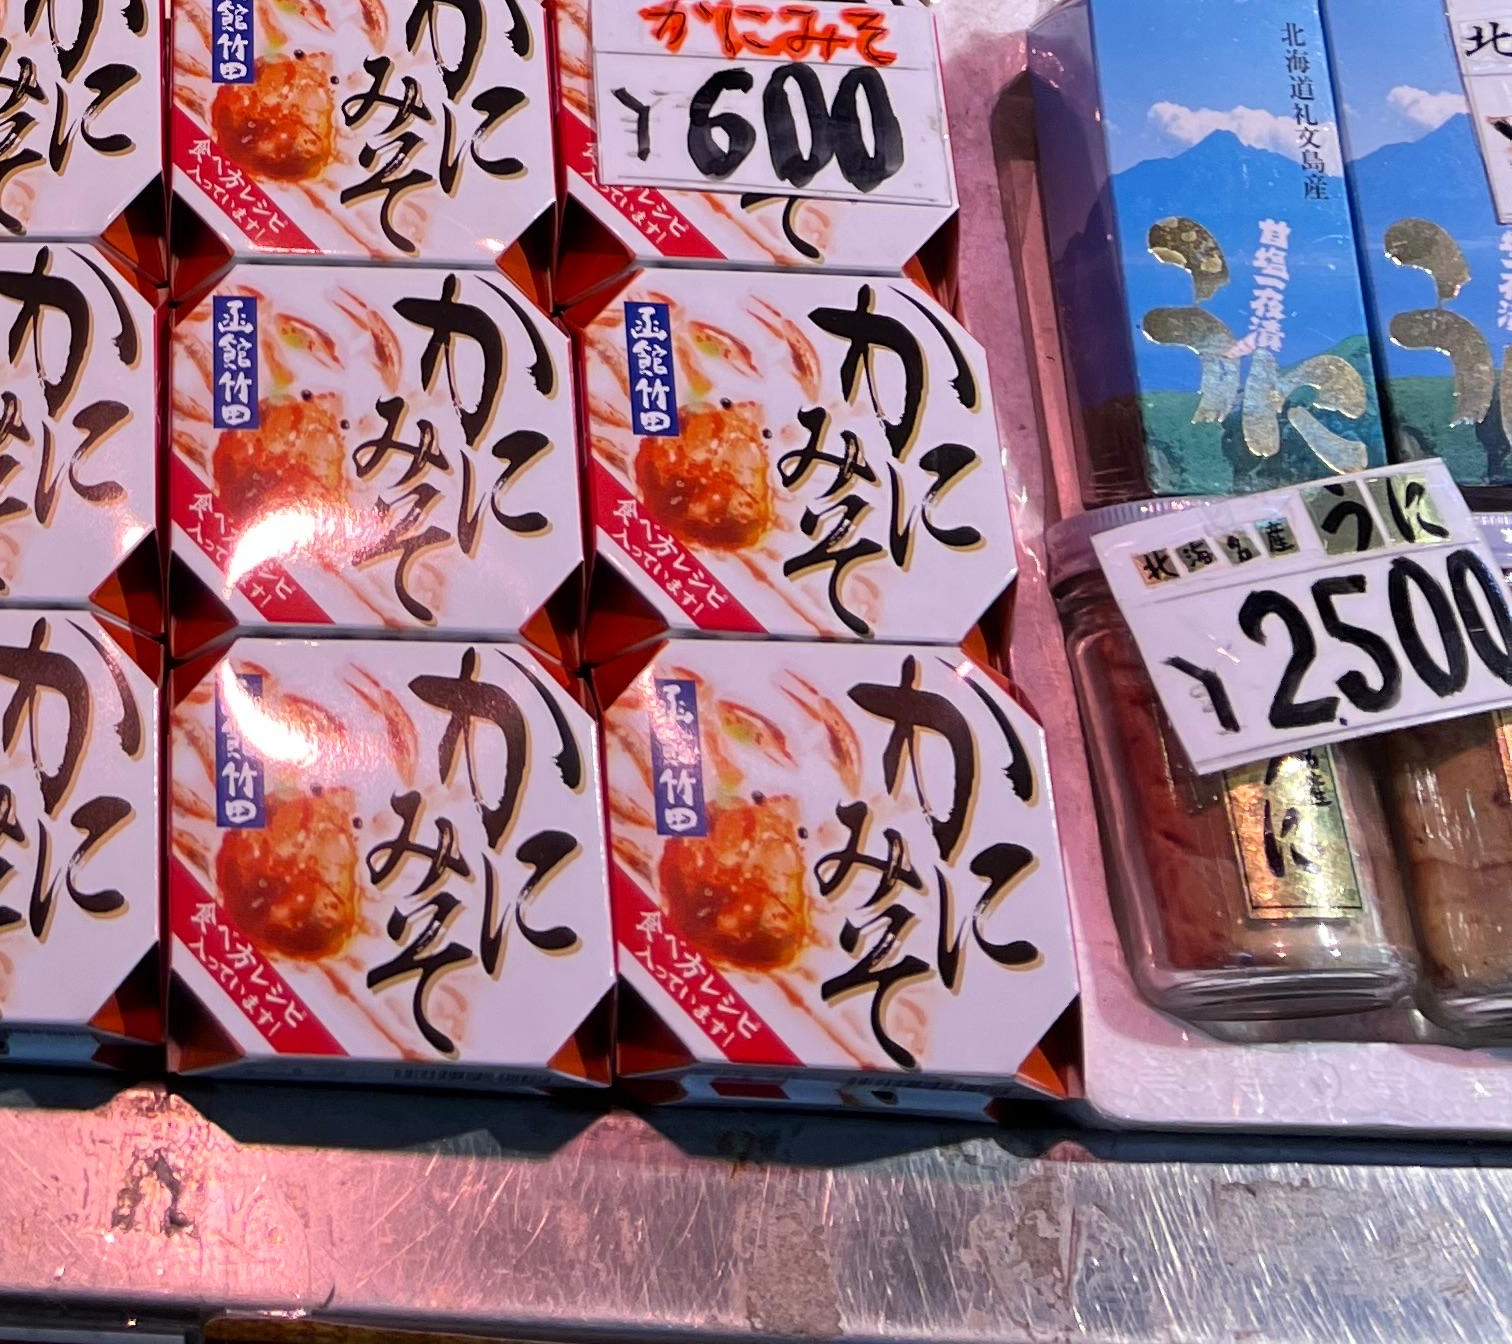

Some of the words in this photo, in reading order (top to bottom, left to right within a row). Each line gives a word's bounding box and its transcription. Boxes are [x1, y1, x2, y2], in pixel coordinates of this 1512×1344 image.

[610, 62, 905, 193] ¥600
[1281, 22, 1331, 201] 北海道礼文島産
[188, 136, 287, 235] 食べ方レシピ
[216, 299, 254, 426] 函館竹田
[630, 306, 673, 432] 函館竹田
[612, 497, 729, 609] 食べ方レシピ
[1323, 483, 1451, 553] うに
[190, 902, 307, 1028] 食べ方レシピ
[635, 909, 762, 1042] 食べ方レシピ
